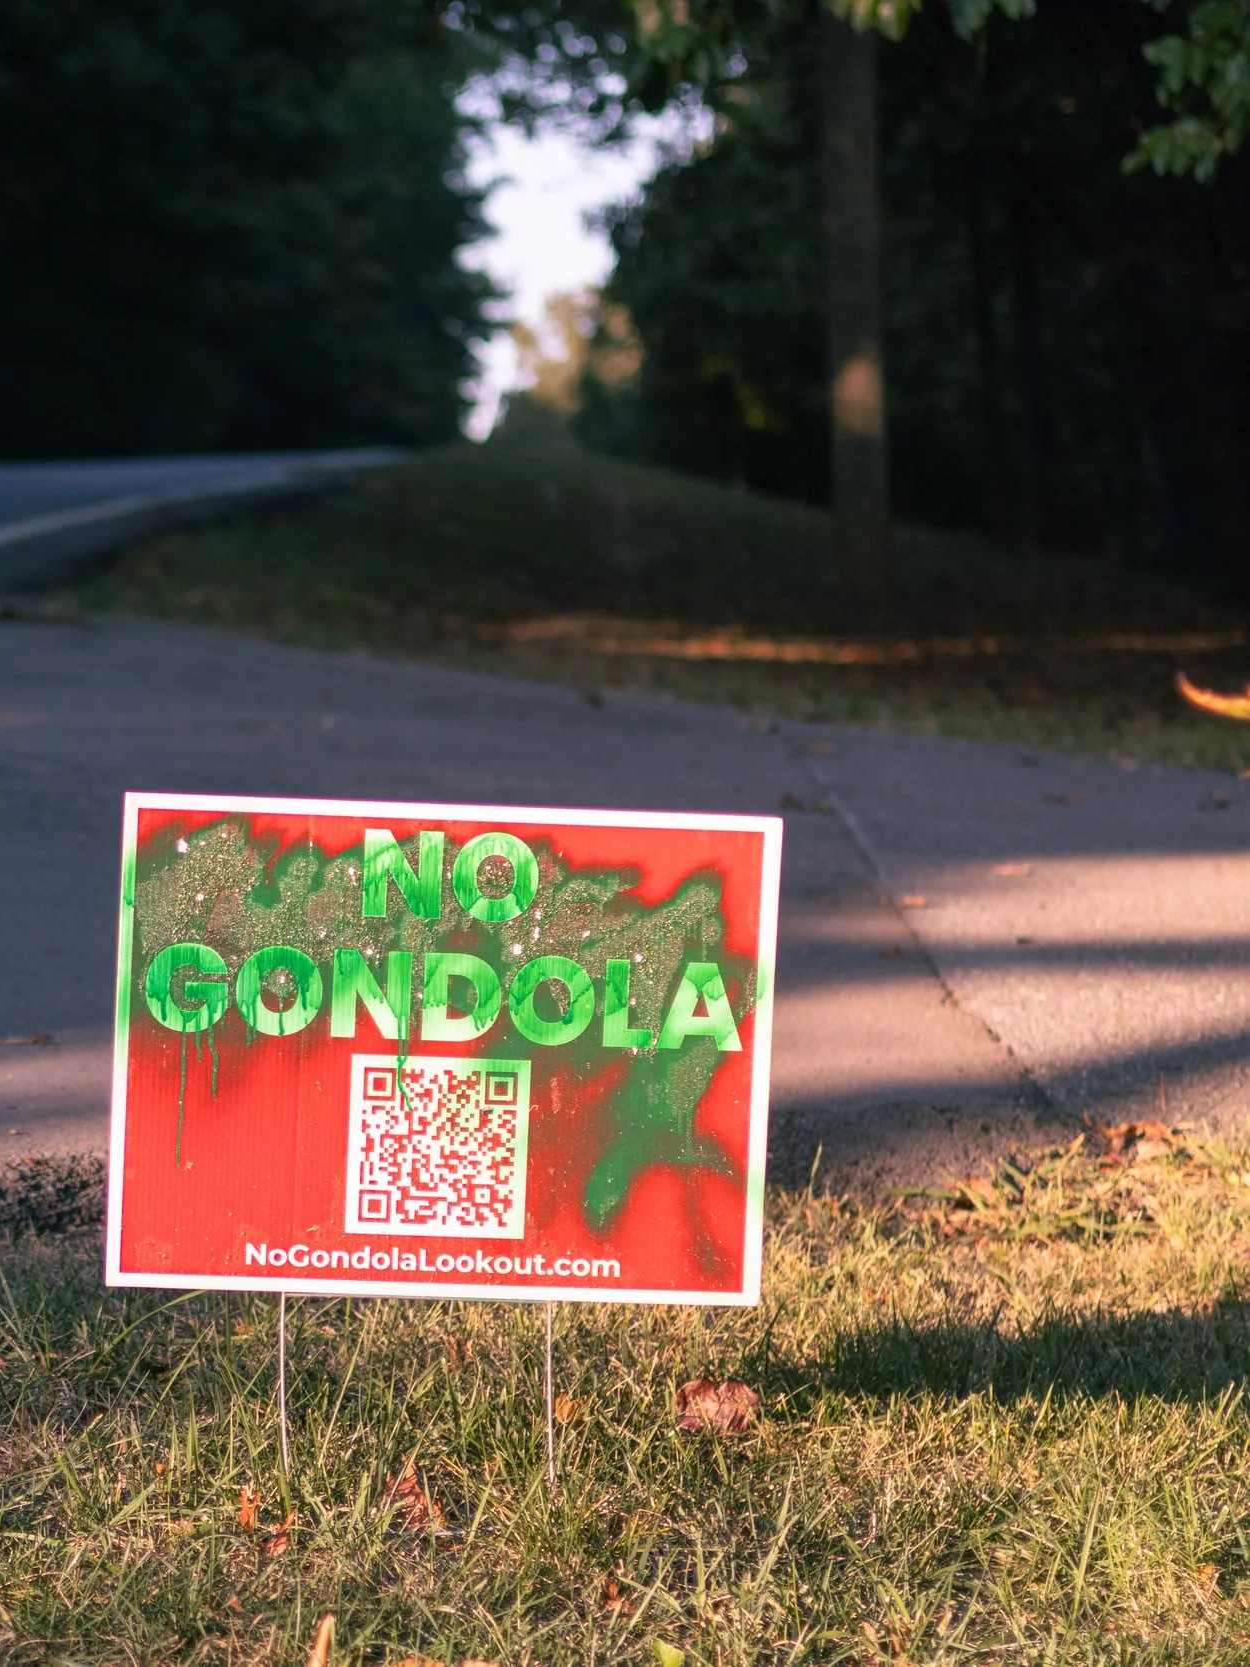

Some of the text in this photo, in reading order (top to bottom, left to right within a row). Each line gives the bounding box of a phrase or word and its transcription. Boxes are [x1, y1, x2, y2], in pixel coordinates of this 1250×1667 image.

[362, 828, 539, 922] NO
[145, 943, 743, 1052] GONDOLA
[244, 1242, 622, 1278] NoGondolaLookout.com
